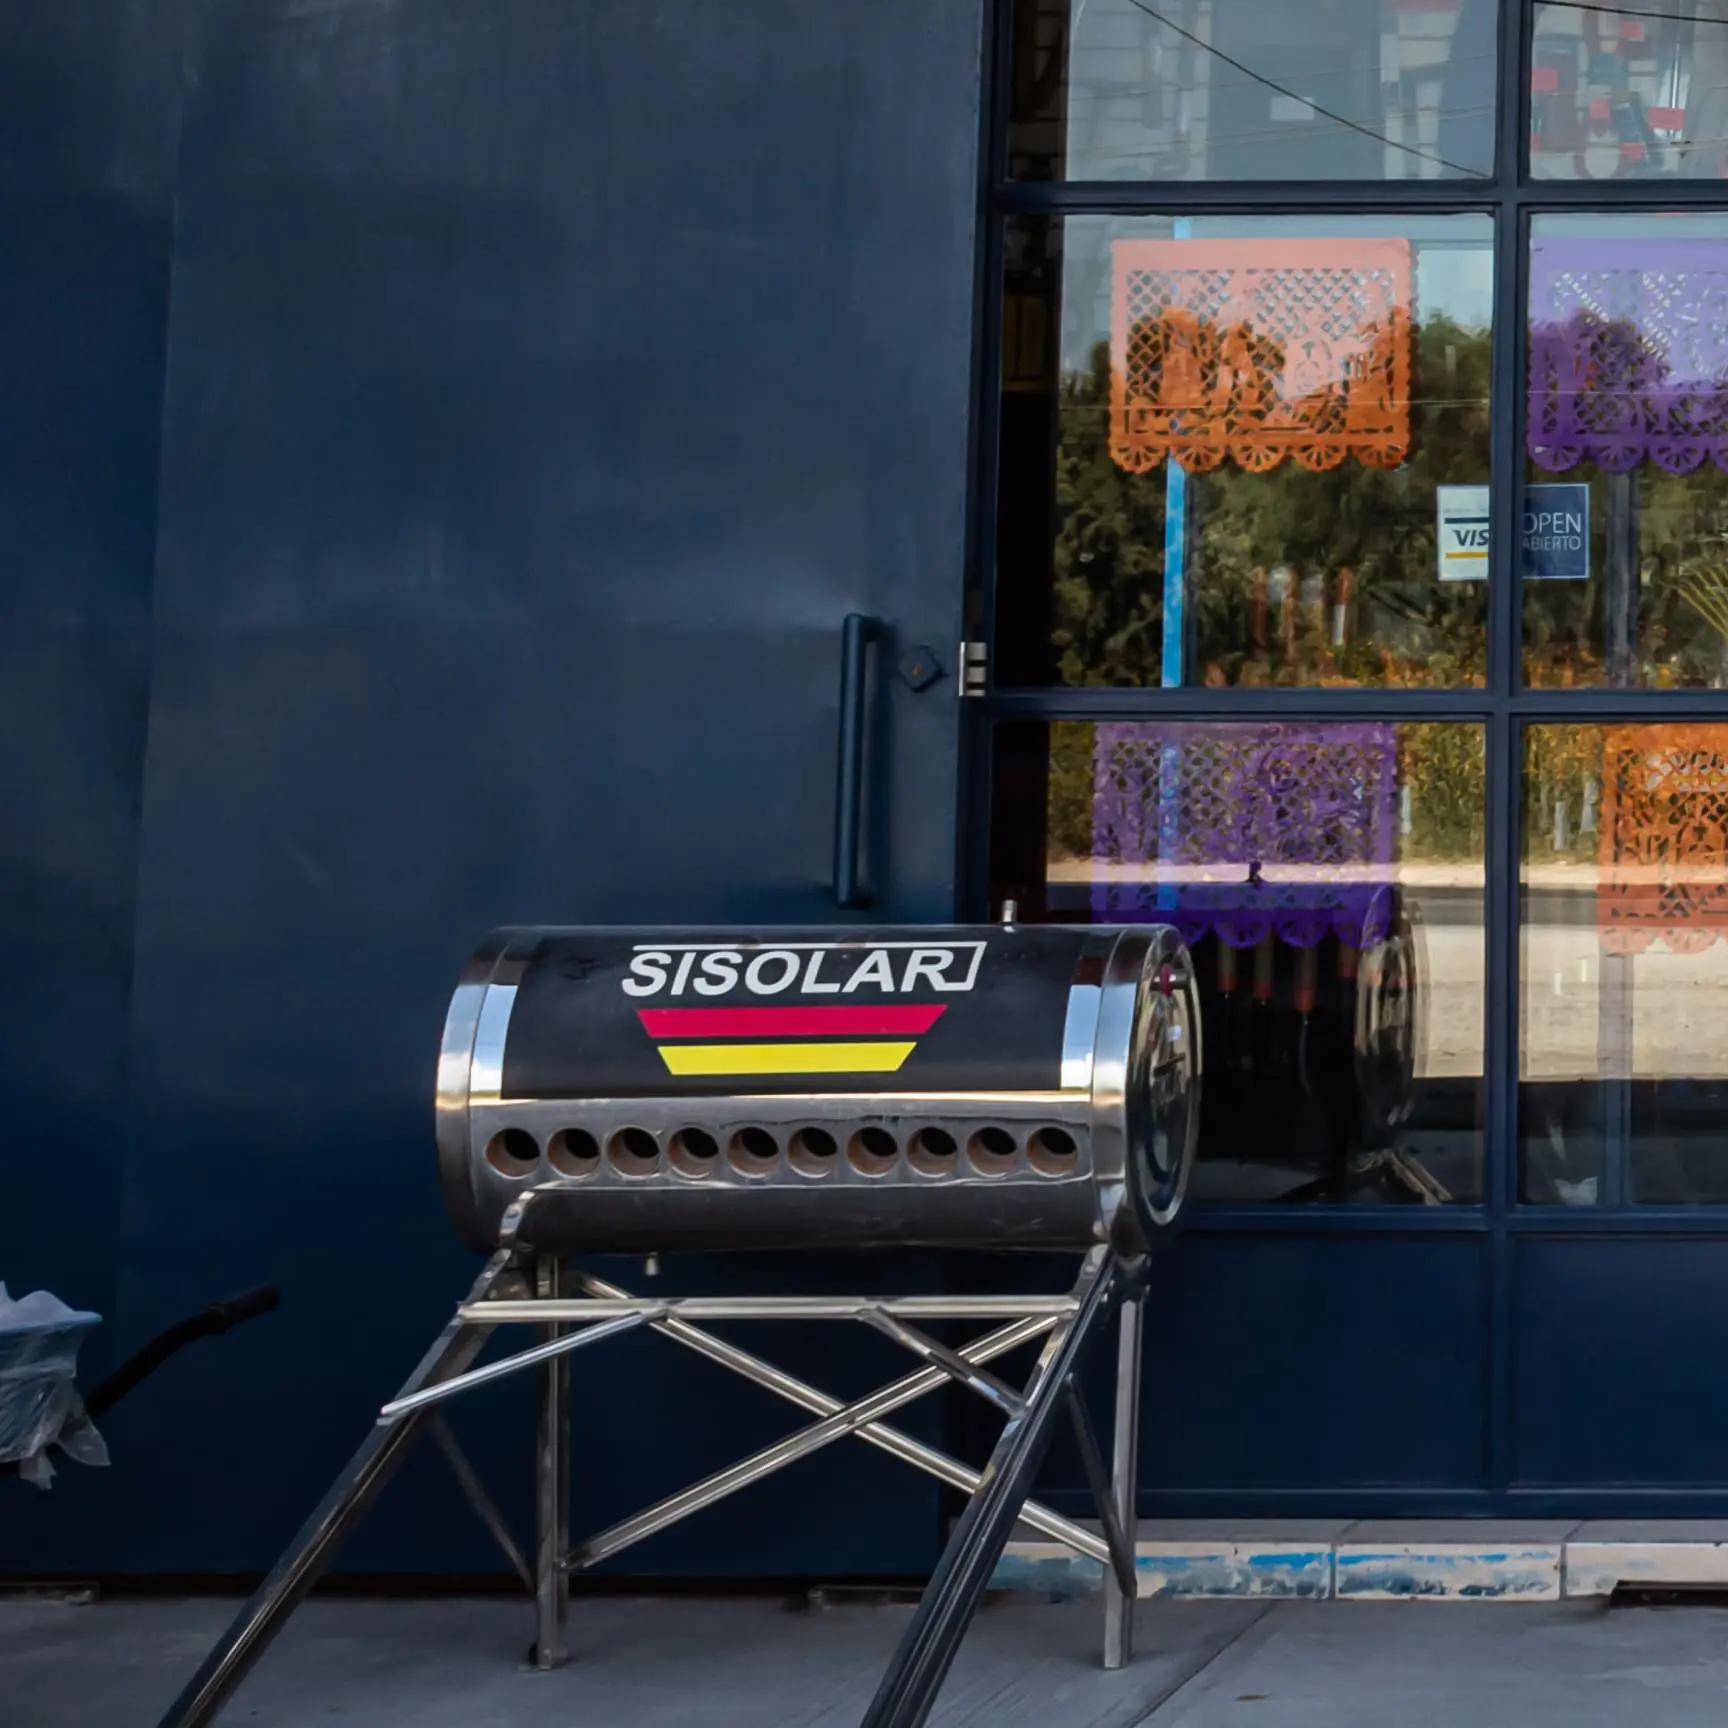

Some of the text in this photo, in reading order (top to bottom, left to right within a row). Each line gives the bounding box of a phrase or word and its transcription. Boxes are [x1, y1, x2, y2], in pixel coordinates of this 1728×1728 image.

[1522, 513, 1581, 534] OPEN
[1453, 529, 1489, 546] VIS
[1522, 535, 1582, 550] ABIERTO
[621, 948, 953, 997] SISOLAR
